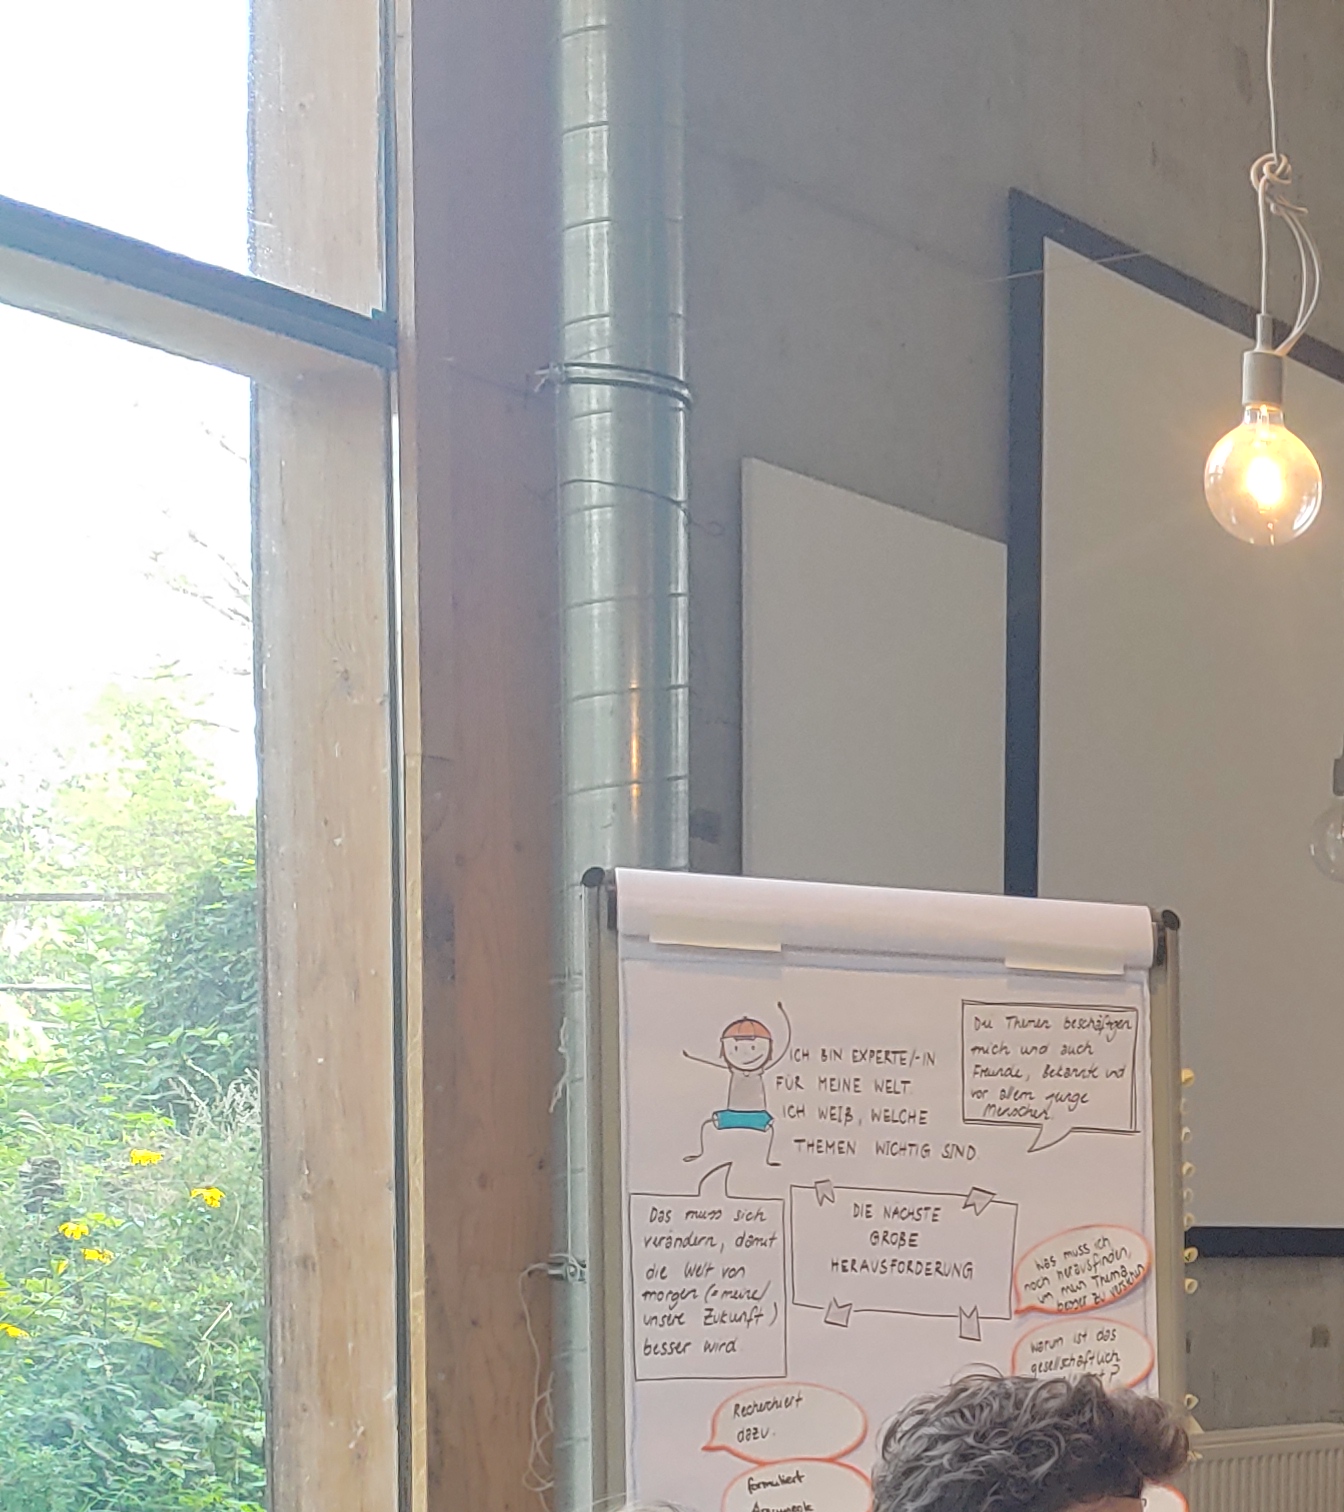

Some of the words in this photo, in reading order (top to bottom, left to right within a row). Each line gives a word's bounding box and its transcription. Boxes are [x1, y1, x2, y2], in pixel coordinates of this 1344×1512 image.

[1005, 1015, 1052, 1030] Themen
[790, 1048, 810, 1063] ICH
[820, 1047, 842, 1063] BIN
[971, 1042, 1011, 1056] mich
[1020, 1043, 1050, 1056] und
[1060, 1042, 1095, 1056] auch
[818, 1076, 862, 1093] MEINE
[1000, 1086, 1036, 1101] allem
[1045, 1091, 1090, 1113] junge
[783, 1104, 806, 1119] ICH
[871, 1108, 929, 1125] WELCHE
[793, 1138, 857, 1156] THEMEN
[875, 1141, 932, 1159] WICHTIG
[649, 1206, 672, 1223] Das
[685, 1209, 723, 1221] muss
[734, 1208, 767, 1223] sich
[853, 1202, 874, 1219] DIE
[735, 1230, 778, 1248] damit
[1063, 1243, 1091, 1260] muss
[1094, 1235, 1111, 1250] ich
[645, 1263, 668, 1280] die
[683, 1261, 716, 1279] Welt
[722, 1265, 746, 1279] von
[831, 1258, 974, 1280] HERAUSFORDERUNG
[1024, 1276, 1050, 1292] noch
[1060, 1280, 1088, 1297] mein
[1091, 1264, 1129, 1289] Thema
[641, 1287, 700, 1311] morgen
[643, 1312, 686, 1328] unsere
[1073, 1331, 1088, 1345] ist
[1096, 1328, 1117, 1342] das
[643, 1337, 693, 1356] besser
[747, 1469, 806, 1494] formuliert
